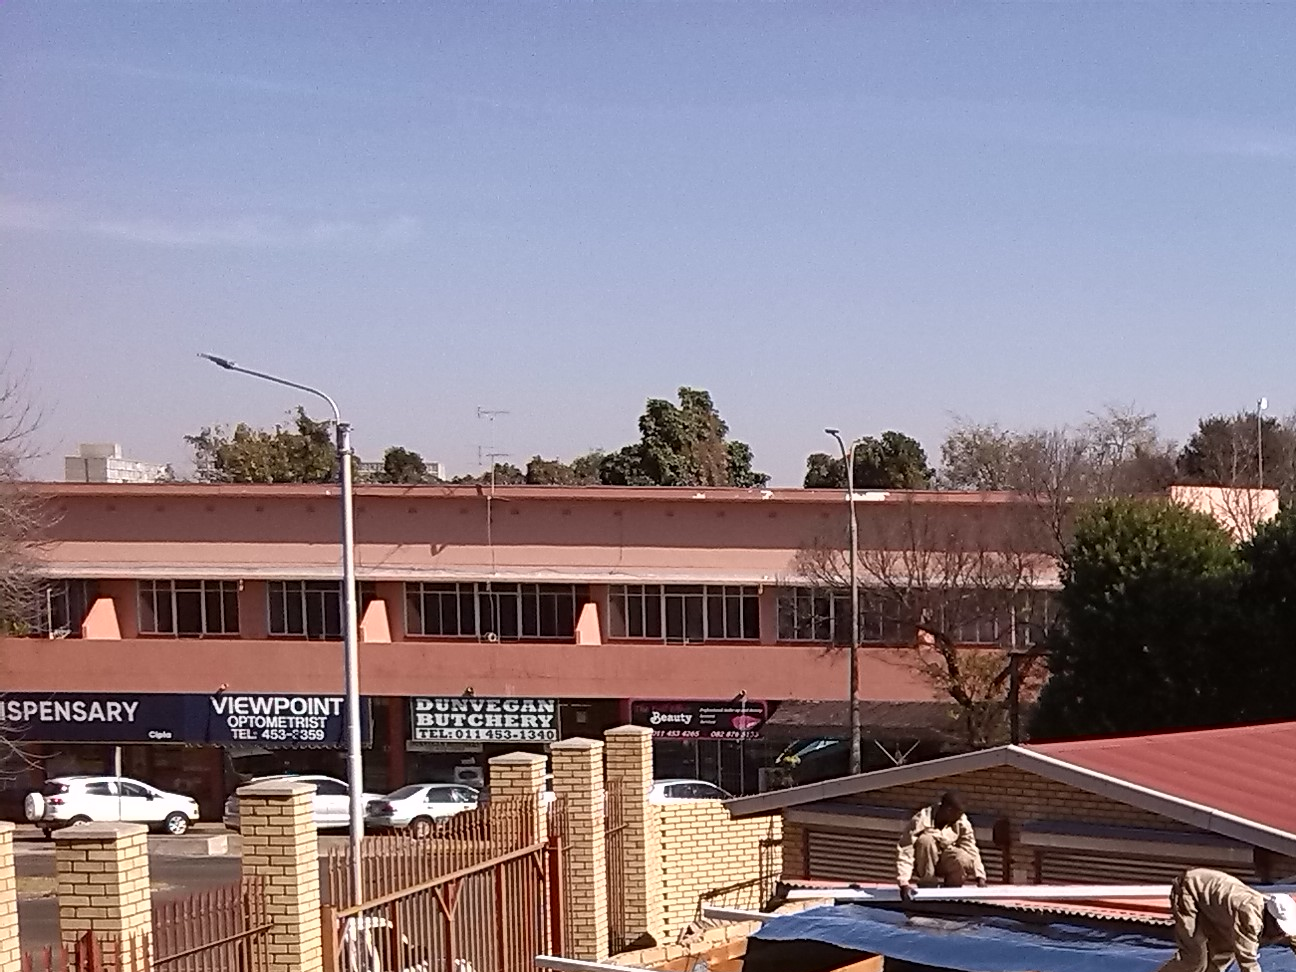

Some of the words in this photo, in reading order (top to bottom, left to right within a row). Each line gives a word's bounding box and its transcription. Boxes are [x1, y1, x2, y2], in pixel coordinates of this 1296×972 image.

[210, 696, 345, 716] VIEWPOINT
[415, 698, 555, 713] DUNVEGAN
[227, 715, 328, 728] OPTOMETRIST
[415, 713, 554, 727] BUTCHERY
[650, 711, 693, 725] Beauty
[230, 728, 258, 740] TEL:
[418, 729, 452, 739] TEL:
[485, 729, 555, 740] 453-1340
